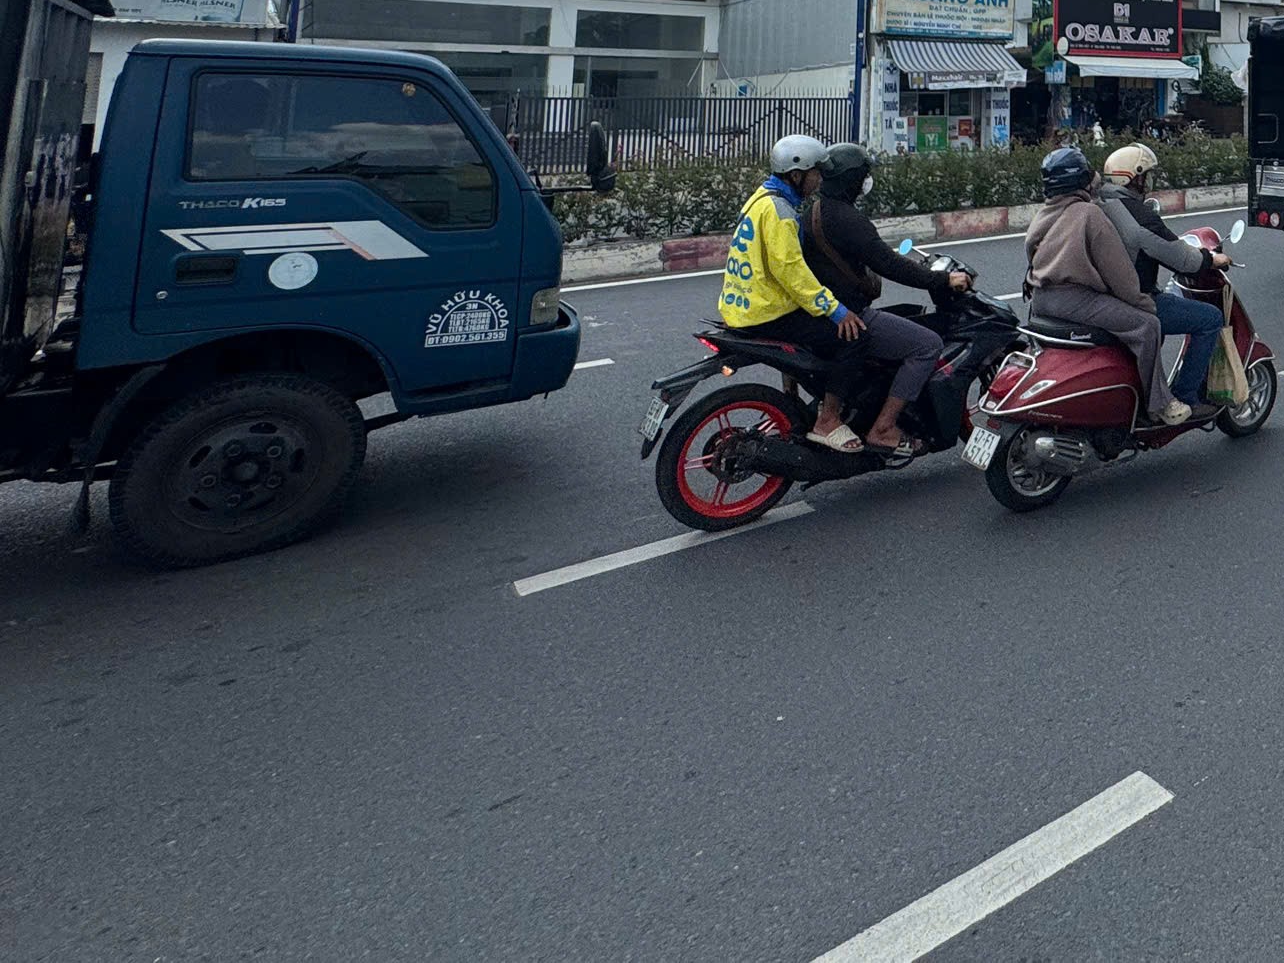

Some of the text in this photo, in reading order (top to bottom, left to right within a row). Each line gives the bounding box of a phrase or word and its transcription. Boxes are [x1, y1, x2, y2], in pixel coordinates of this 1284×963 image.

[1065, 23, 1171, 46] OSAKAR
[178, 197, 287, 210] THACO K165
[484, 293, 510, 328] KHOA
